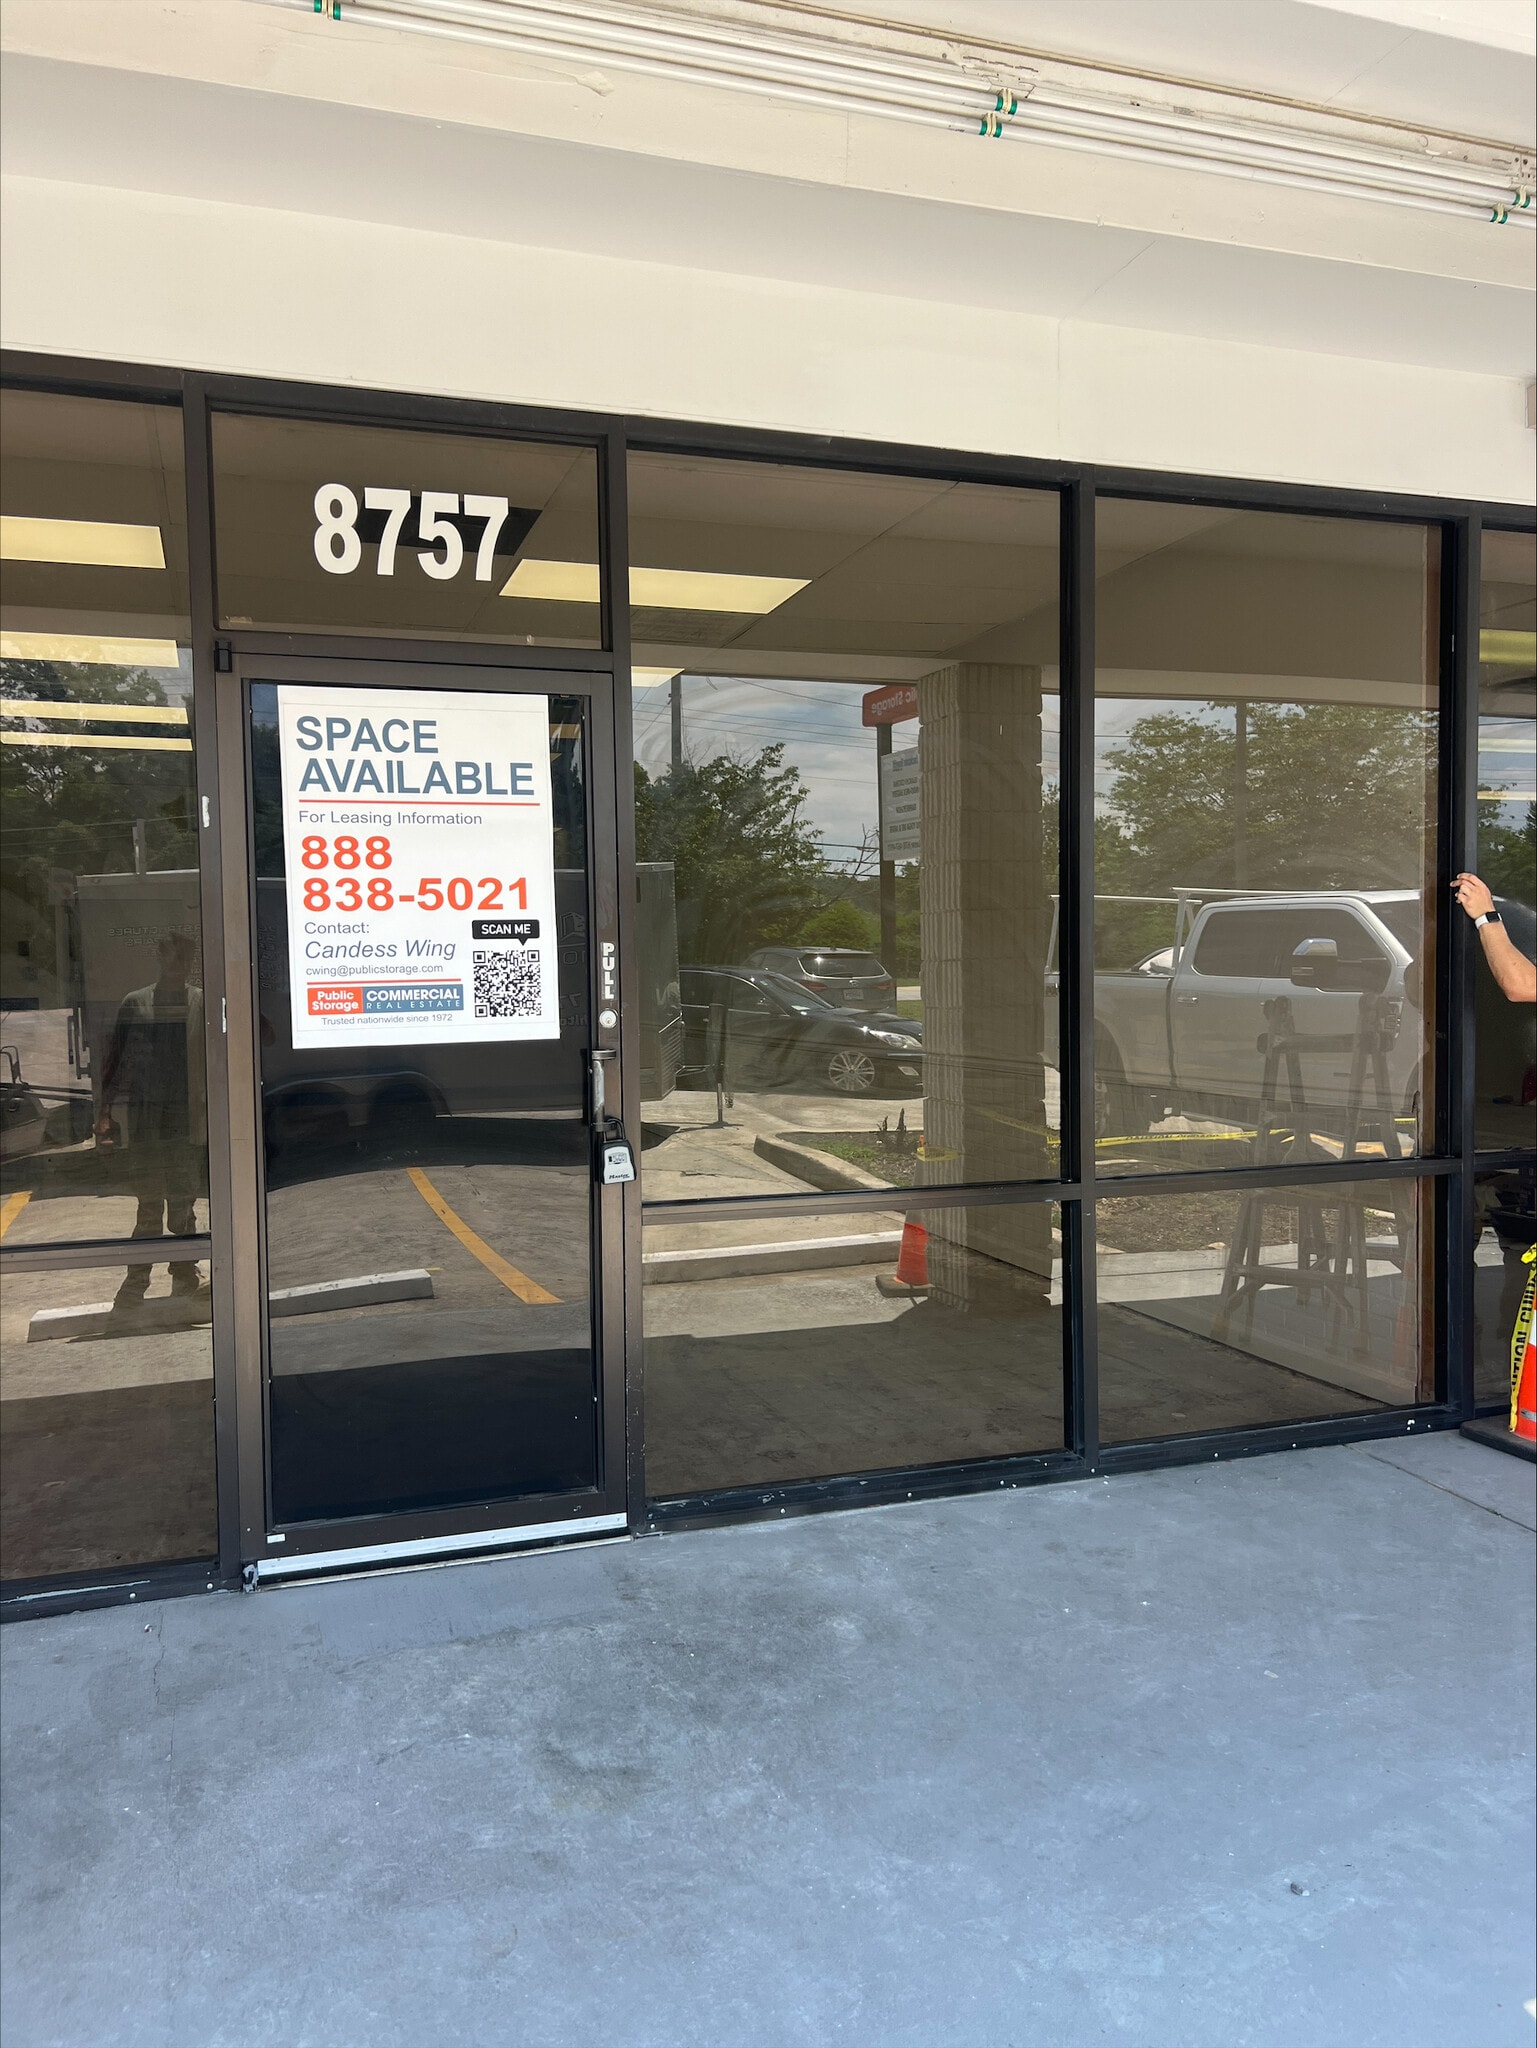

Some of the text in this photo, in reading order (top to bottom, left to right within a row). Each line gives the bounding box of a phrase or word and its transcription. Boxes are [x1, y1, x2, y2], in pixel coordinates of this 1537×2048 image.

[313, 483, 509, 582] 8757
[296, 716, 439, 753] SPACE
[298, 758, 535, 795] AVAILABLE
[299, 810, 482, 826] For Leasing Information
[301, 835, 392, 870] 888
[303, 877, 528, 911] 838-5021
[304, 922, 370, 934] Contact:
[481, 923, 531, 935] SCAN ME
[305, 939, 457, 960] Candess Wing
[306, 964, 443, 977] cwing@publicstorage.com
[603, 942, 615, 1000] PULL
[317, 990, 354, 1001] Public
[366, 987, 461, 1001] COMMERCIAL
[312, 999, 359, 1012] Storage
[366, 999, 461, 1009] REAL ESTATE
[321, 1013, 453, 1026] Trusted nationwide since 1972
